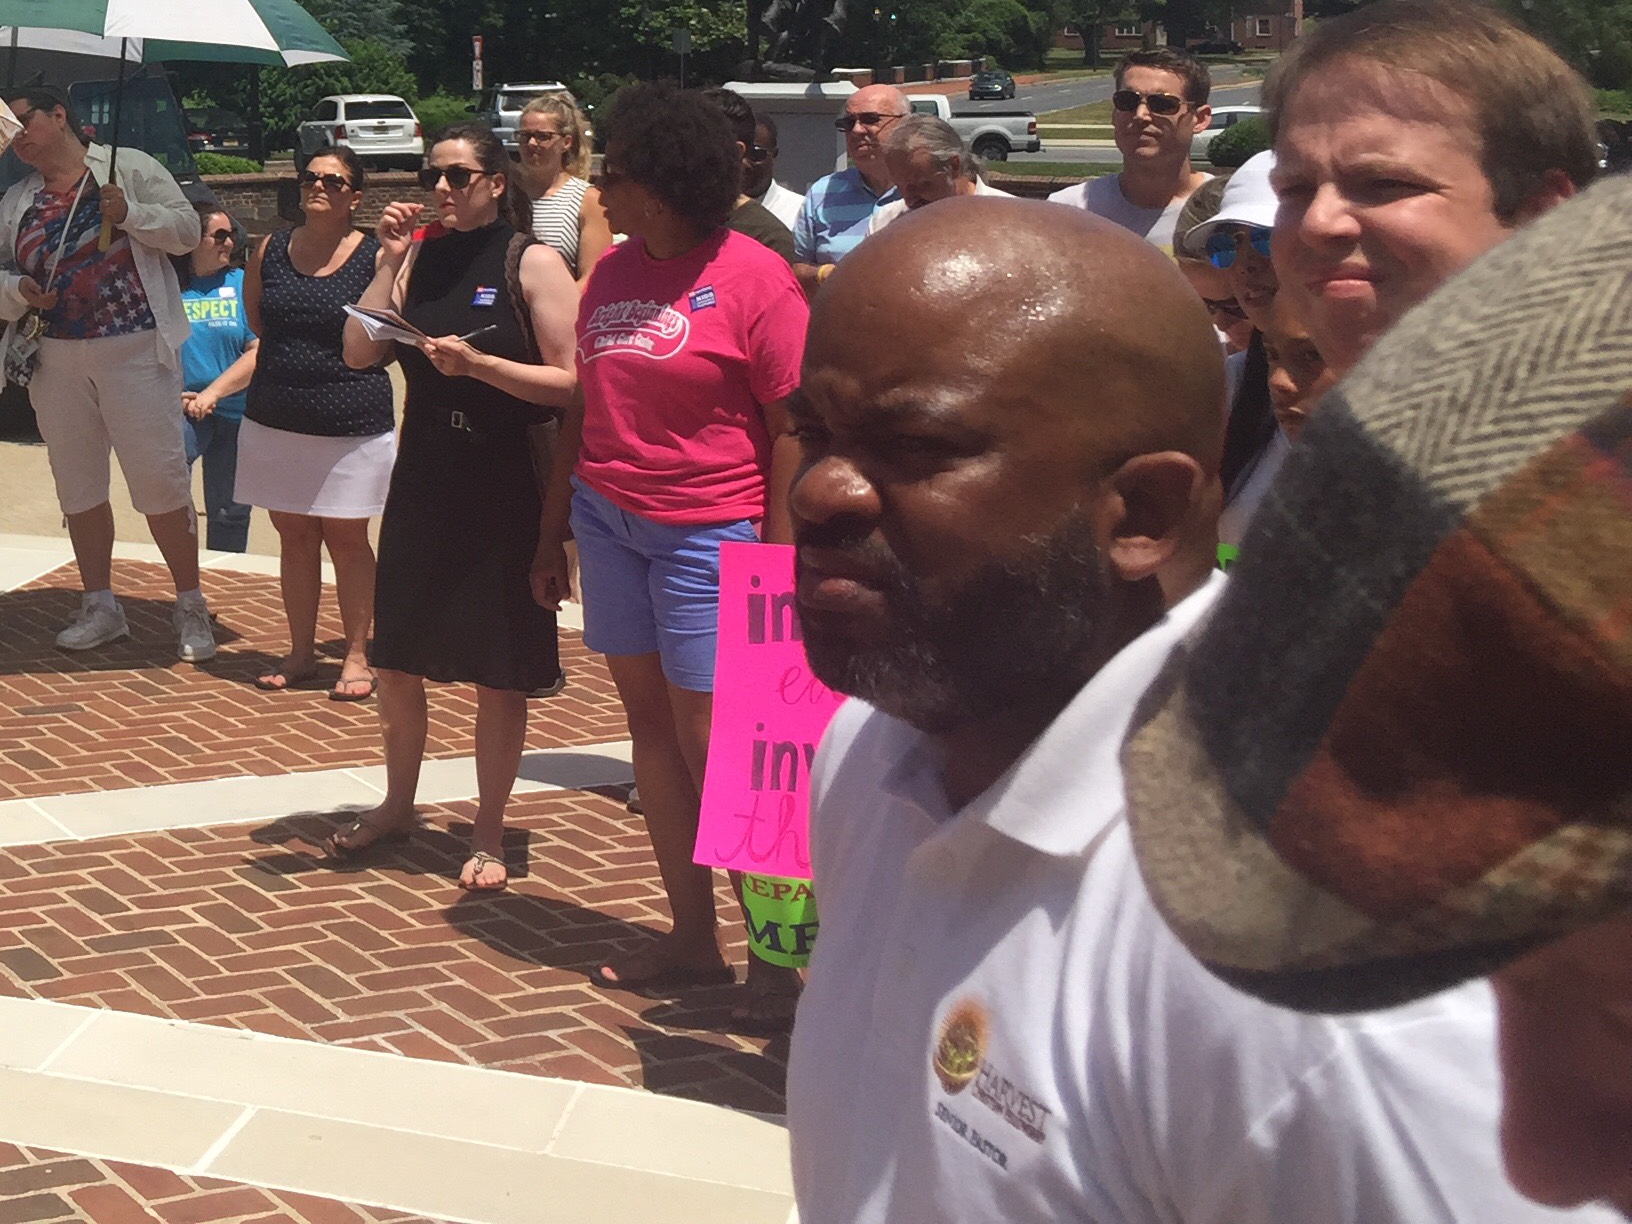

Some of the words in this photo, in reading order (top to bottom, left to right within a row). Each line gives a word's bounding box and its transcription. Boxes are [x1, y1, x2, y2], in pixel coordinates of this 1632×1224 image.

[183, 300, 238, 320] ESPECT
[714, 794, 811, 867] th
[974, 1058, 1052, 1132] HARVEST
